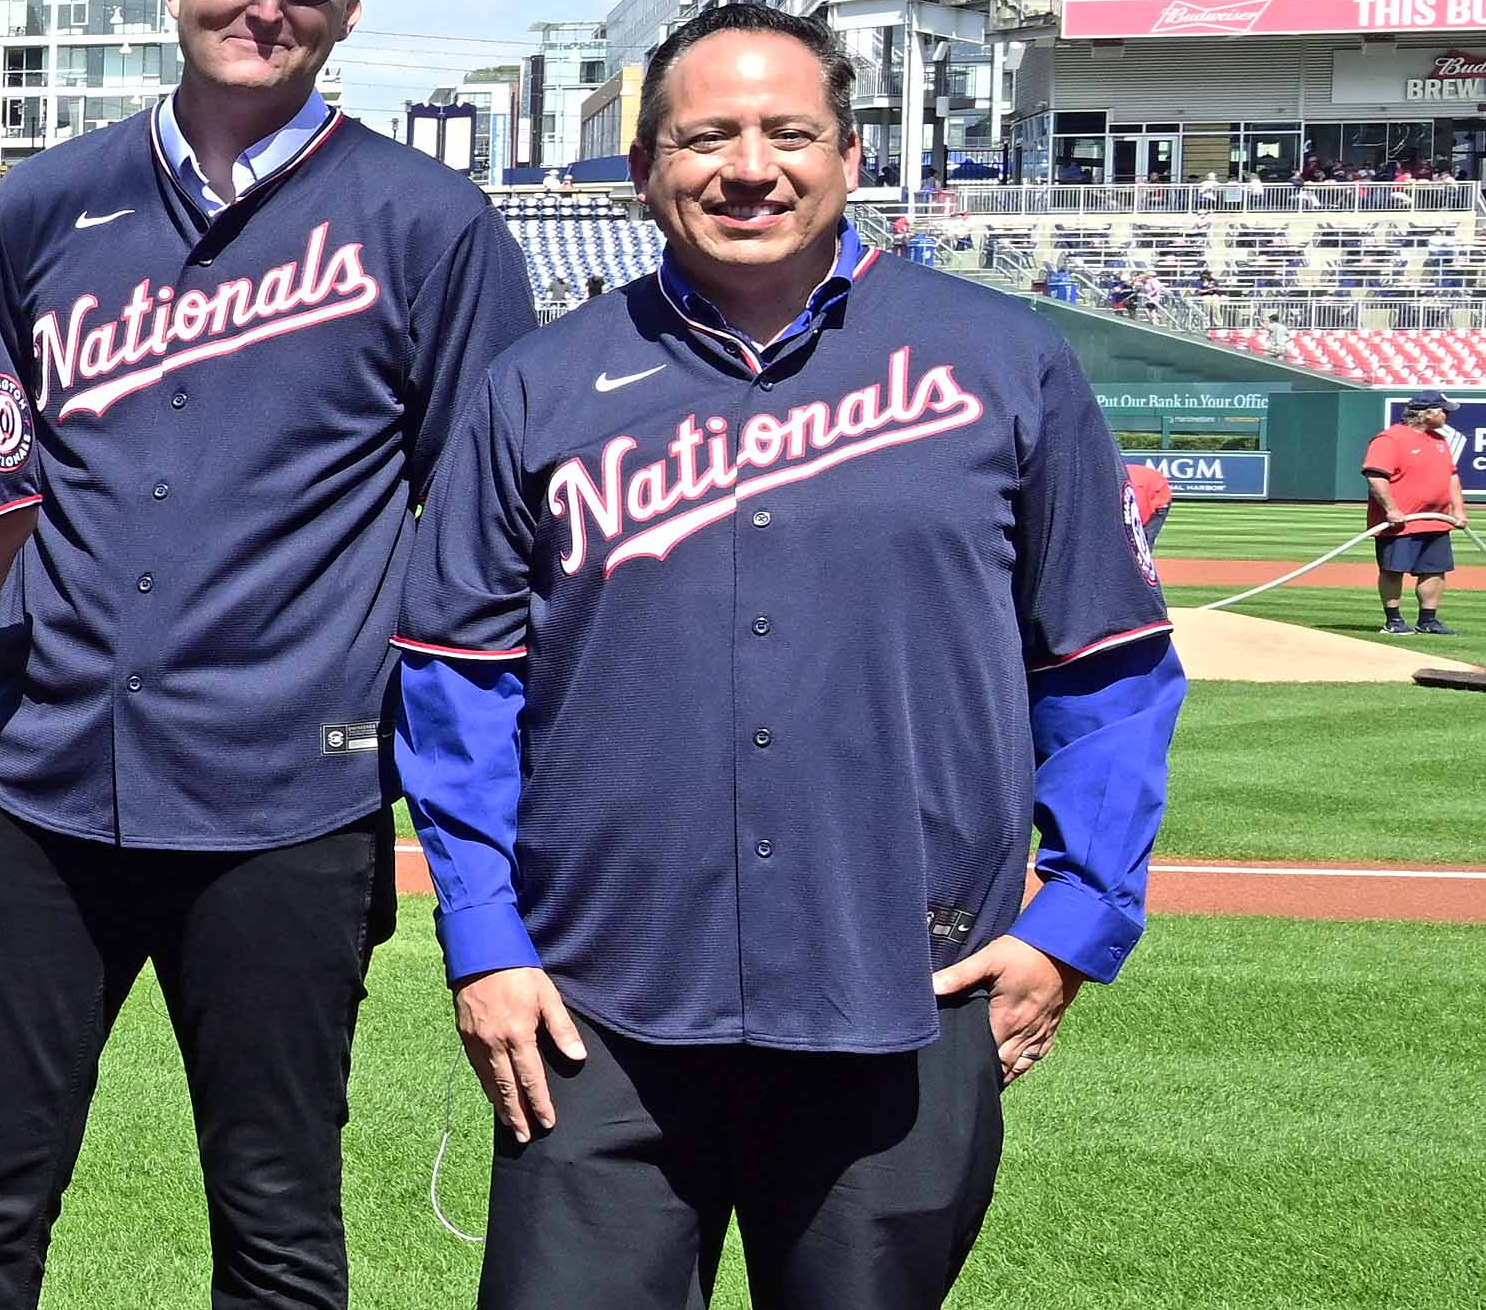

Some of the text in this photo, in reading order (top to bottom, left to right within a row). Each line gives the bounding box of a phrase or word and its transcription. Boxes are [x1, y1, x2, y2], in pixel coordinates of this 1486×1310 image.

[1163, 5, 1259, 24] Budweiser
[32, 221, 379, 422] Nationals
[1097, 394, 1118, 408] Put
[1121, 394, 1146, 408] Our
[1149, 394, 1183, 408] Bank
[1185, 394, 1198, 408] in
[1200, 394, 1231, 408] Your
[548, 346, 984, 578] Nationals
[1145, 458, 1224, 479] MGM
